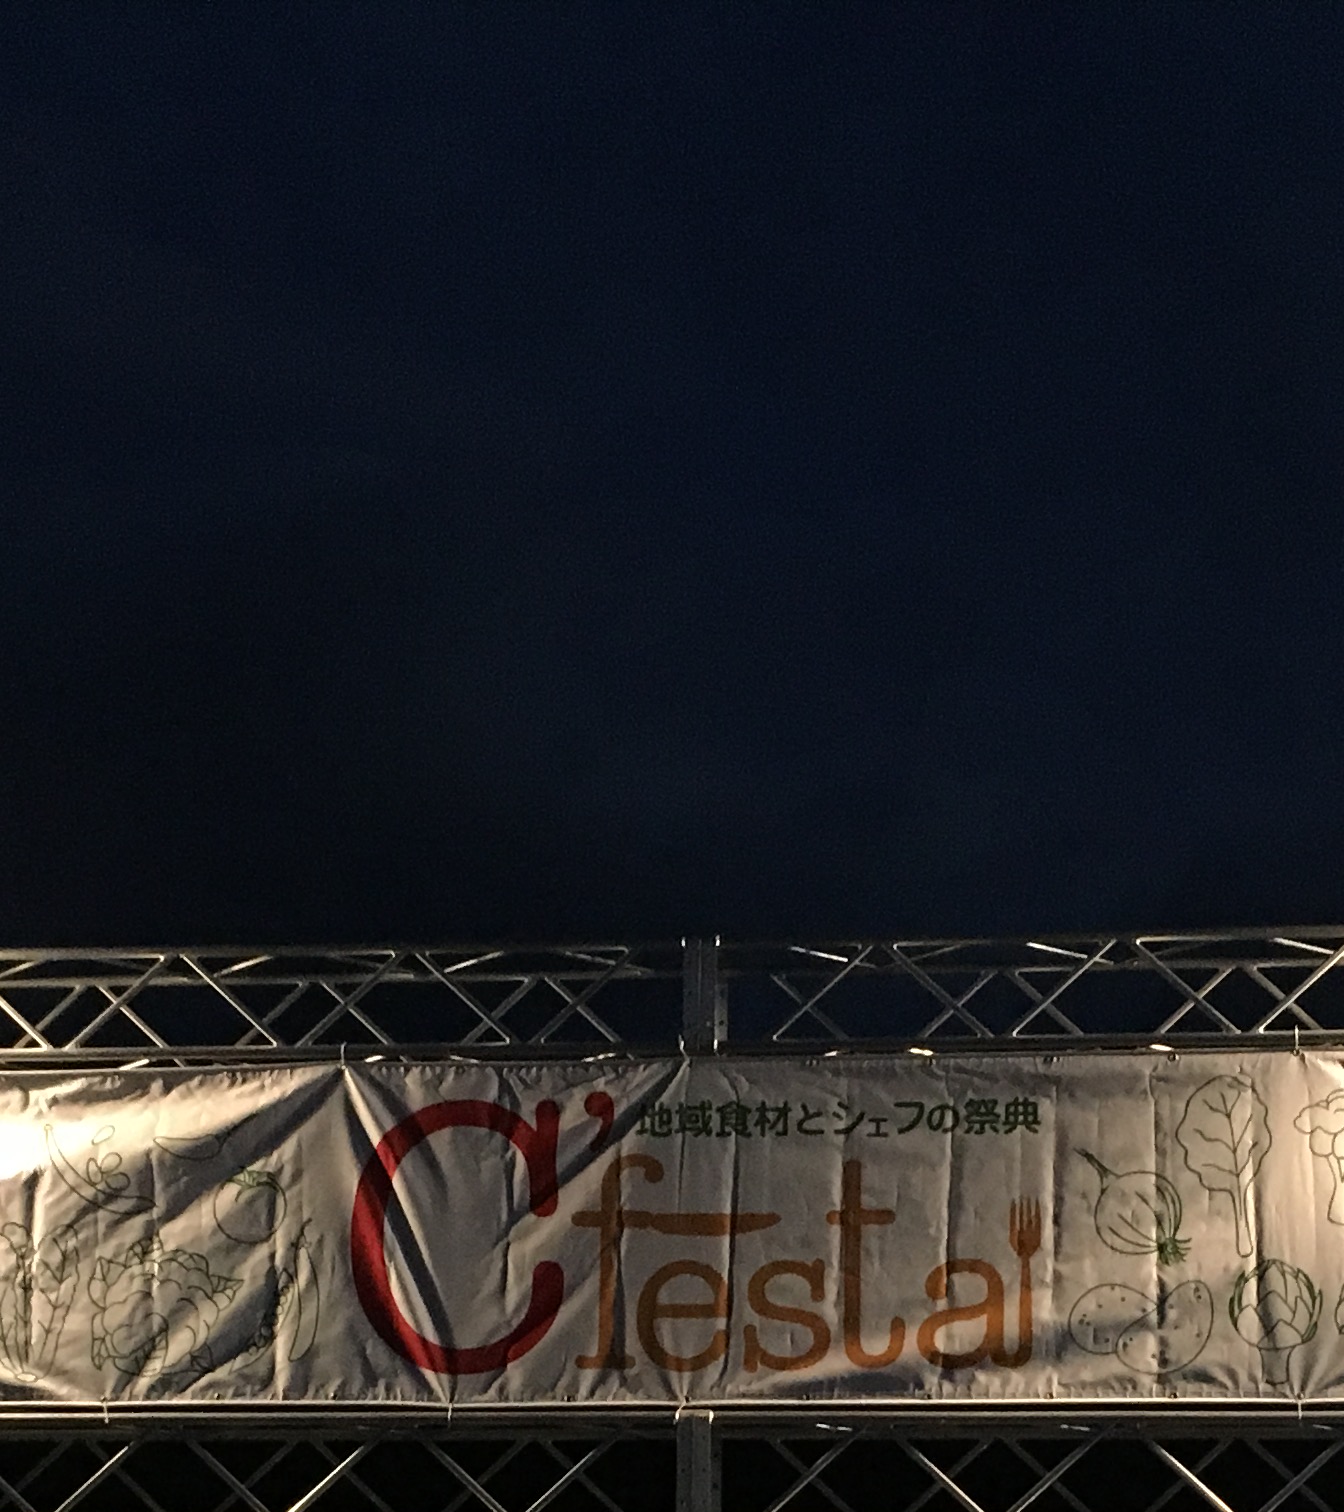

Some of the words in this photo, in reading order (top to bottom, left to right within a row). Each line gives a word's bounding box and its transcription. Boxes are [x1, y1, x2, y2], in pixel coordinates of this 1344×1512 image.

[637, 1097, 1042, 1139] 地域食材とシェフの祭典
